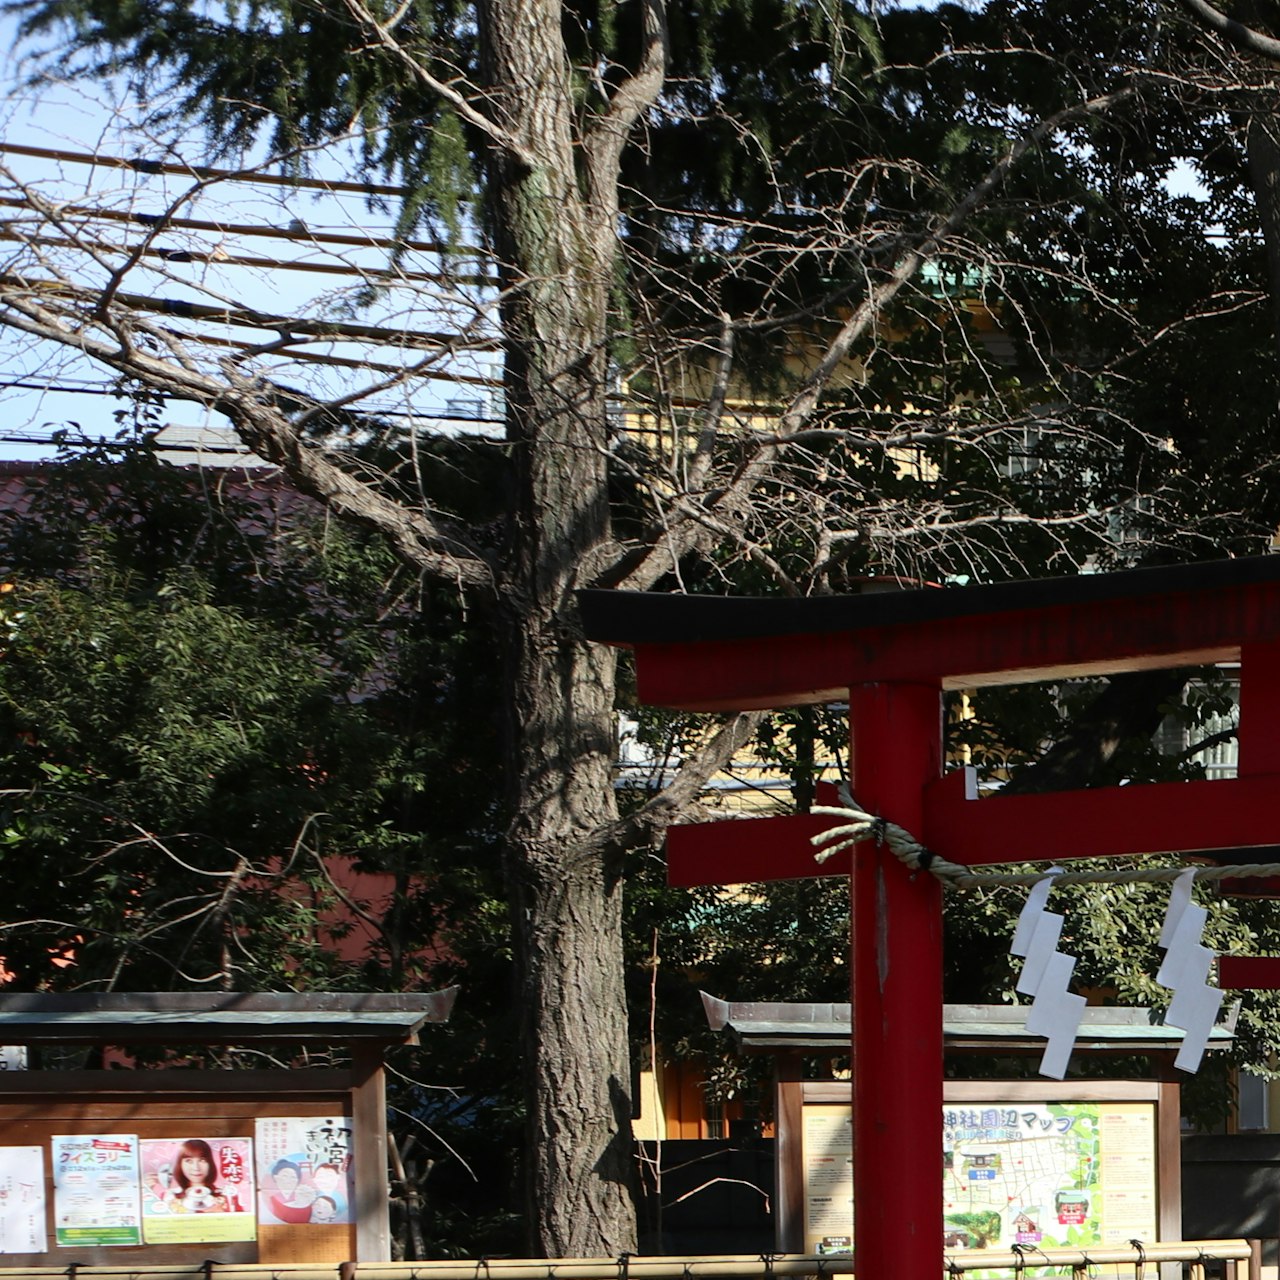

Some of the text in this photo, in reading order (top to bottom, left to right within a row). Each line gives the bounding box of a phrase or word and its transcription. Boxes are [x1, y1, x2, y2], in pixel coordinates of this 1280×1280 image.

[944, 1108, 1076, 1134] 神社周辺マップ
[305, 1130, 319, 1164] まいり
[320, 1119, 352, 1164] 初宮
